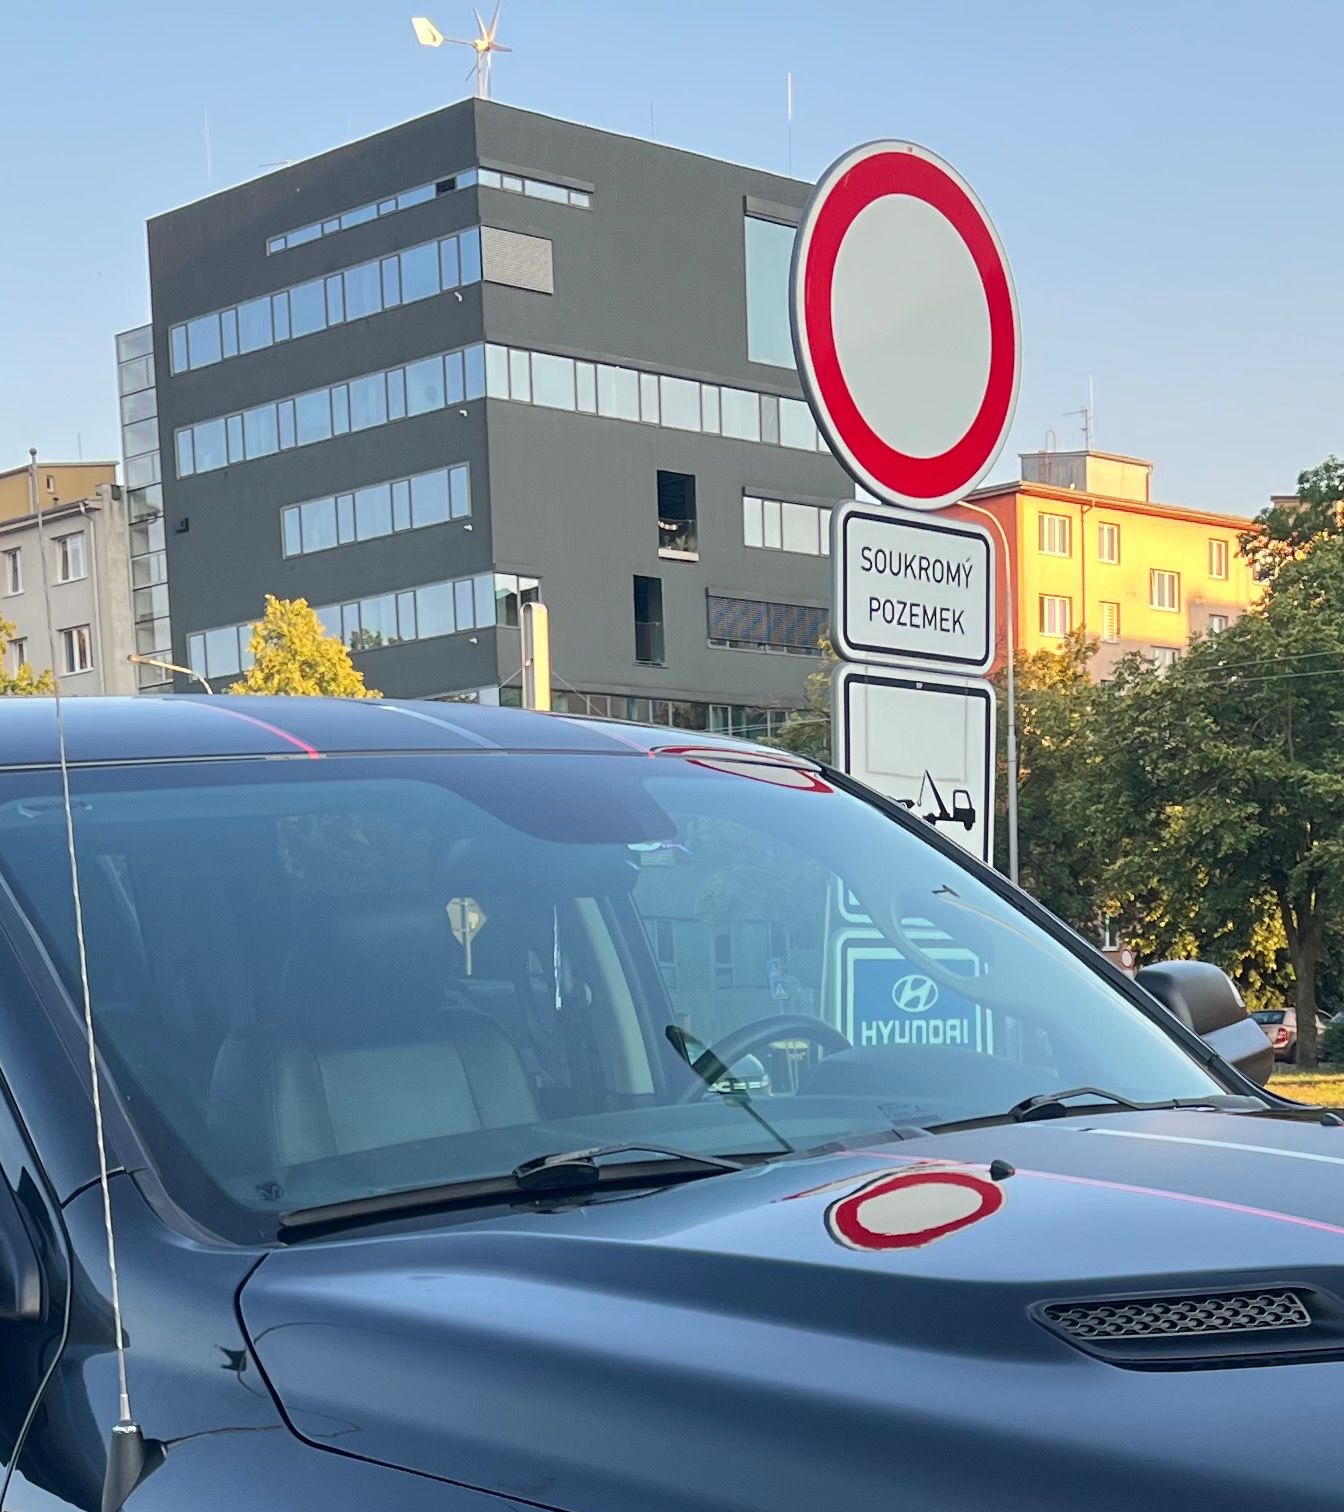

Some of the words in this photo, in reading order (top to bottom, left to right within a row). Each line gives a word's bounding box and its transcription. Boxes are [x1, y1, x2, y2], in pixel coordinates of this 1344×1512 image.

[861, 546, 973, 588] SOUKROMÝ
[869, 597, 965, 636] POZEMEK
[861, 1018, 969, 1047] HYUNDAI
